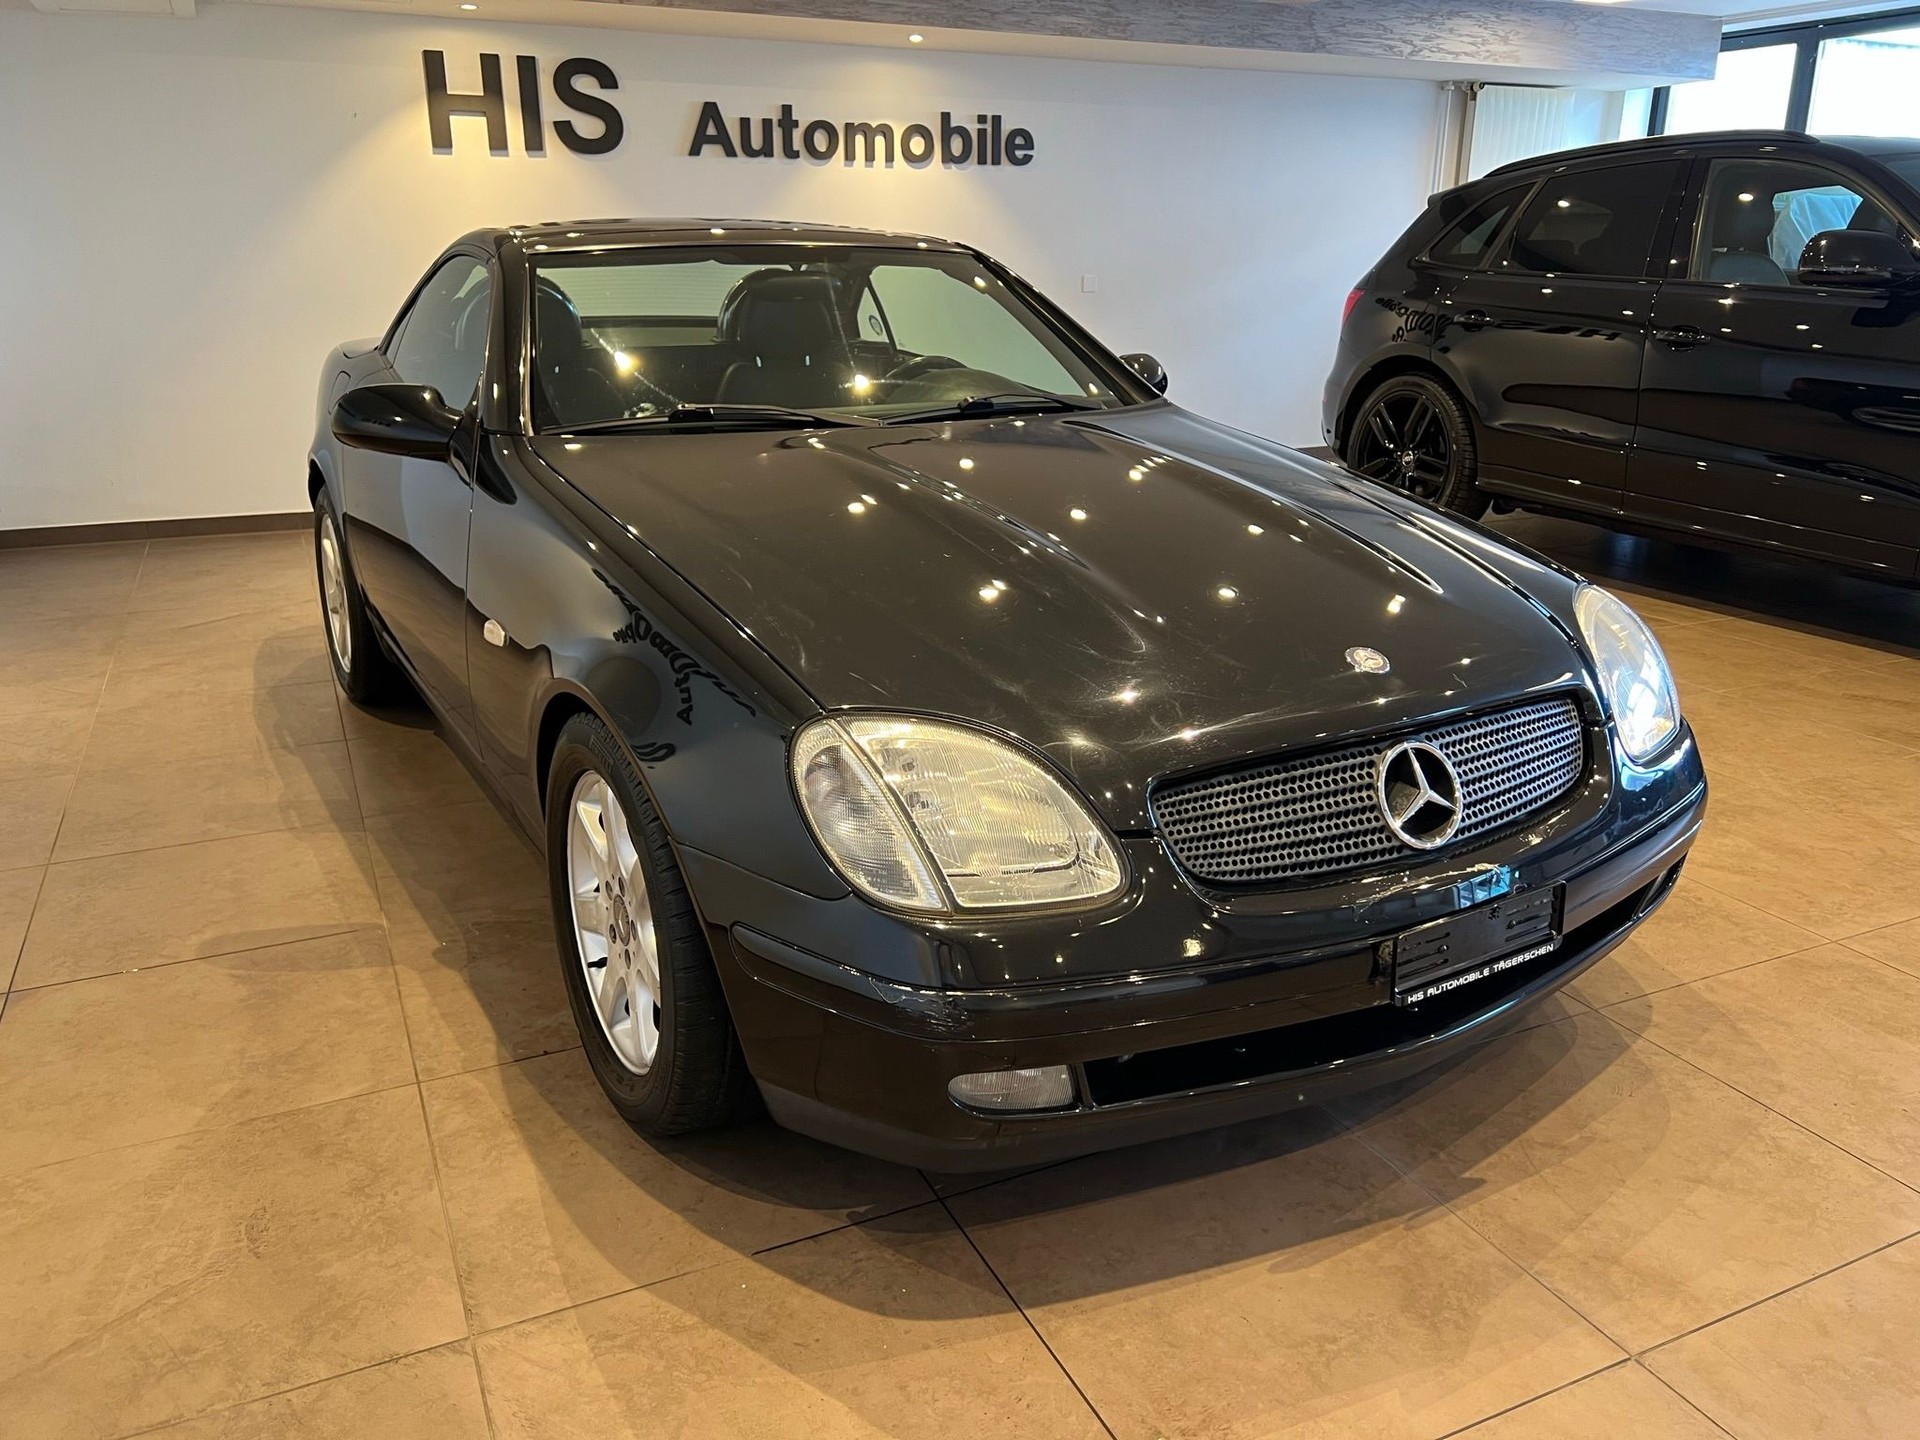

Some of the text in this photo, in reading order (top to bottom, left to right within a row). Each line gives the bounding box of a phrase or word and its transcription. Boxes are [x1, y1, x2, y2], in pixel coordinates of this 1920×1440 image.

[422, 49, 1035, 166] HIS Automobile
[1407, 991, 1425, 1004] HIS
[1427, 967, 1490, 997] AUTOMOBILE
